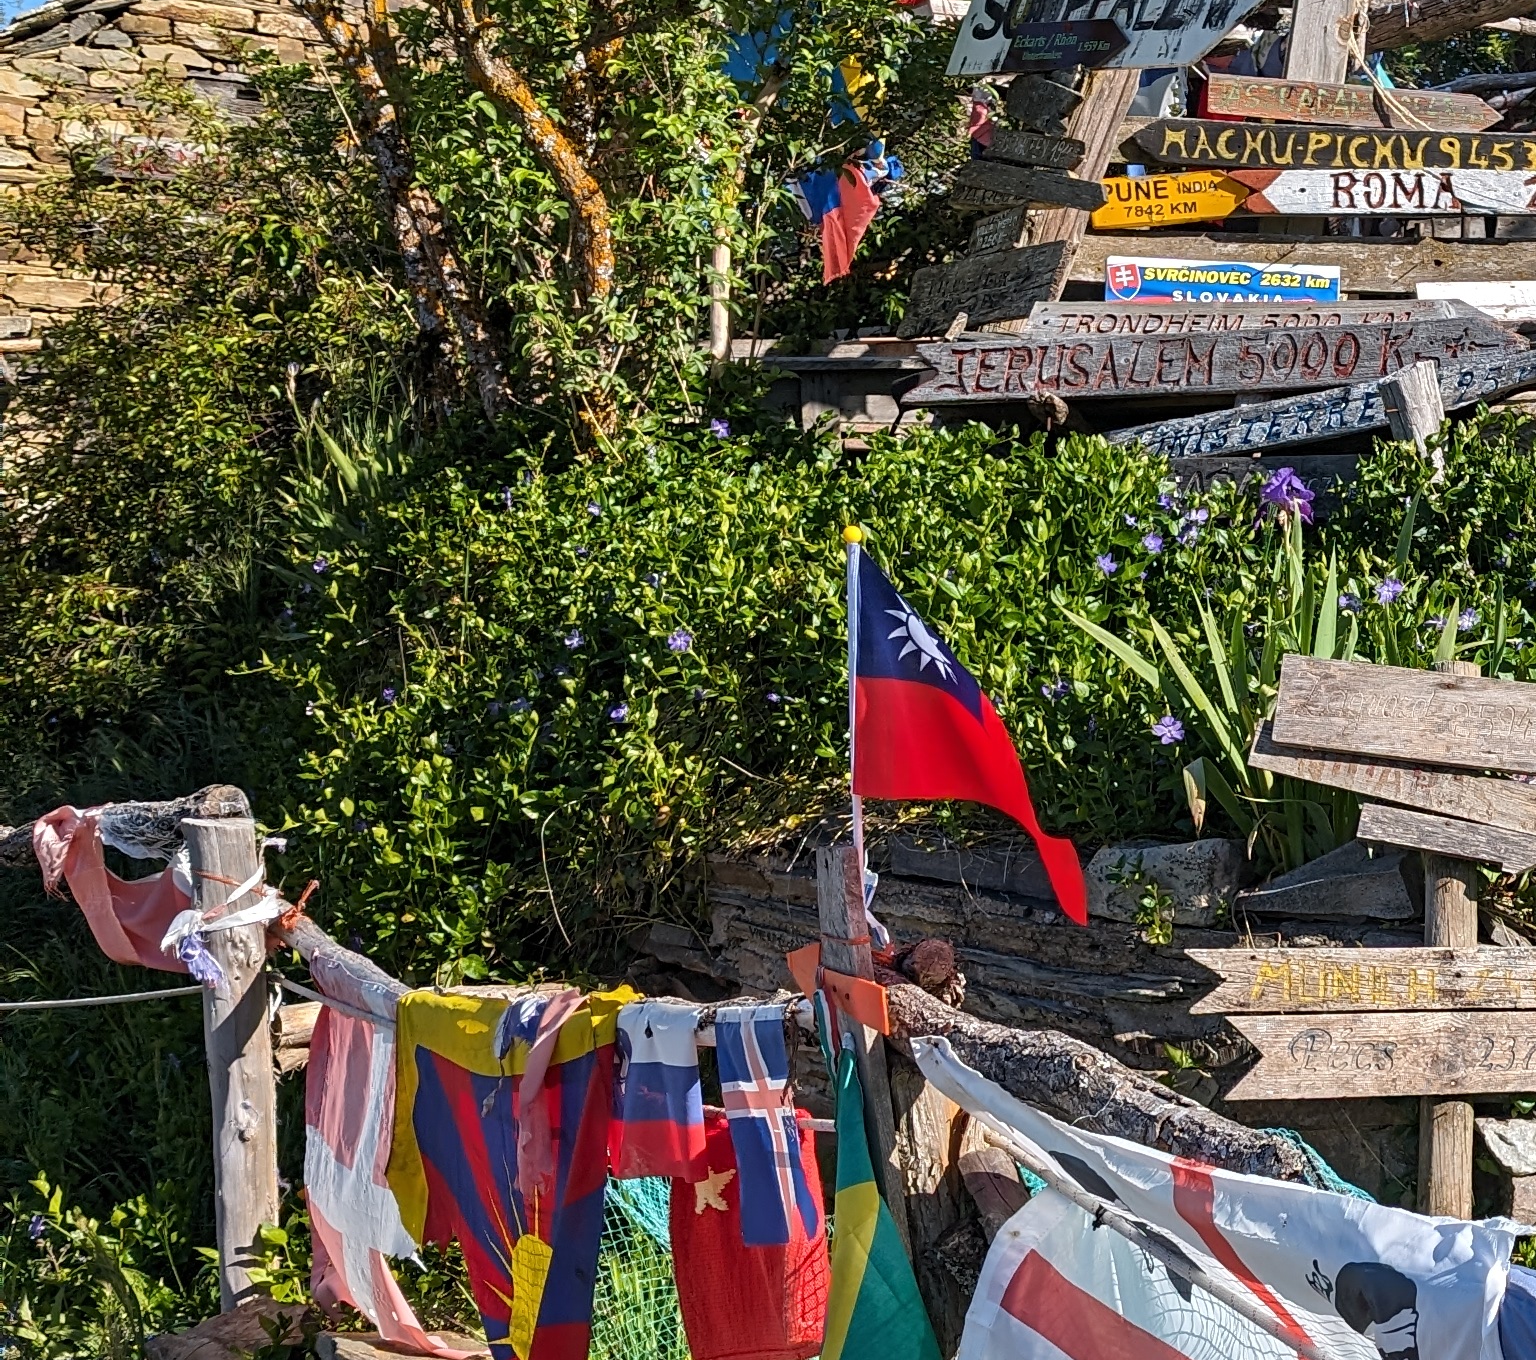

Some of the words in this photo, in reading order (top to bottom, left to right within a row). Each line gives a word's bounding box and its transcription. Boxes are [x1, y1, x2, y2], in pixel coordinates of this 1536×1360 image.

[1177, 179, 1218, 194] INDIA
[1329, 171, 1461, 210] ROMA
[1123, 203, 1165, 218] 7842
[1170, 202, 1198, 215] KM
[1143, 266, 1252, 285] SVRČINOVEC
[1260, 275, 1302, 289] 2632
[1305, 276, 1331, 289] km
[1172, 290, 1284, 303] SLOVAKIA
[1058, 313, 1245, 334] TRONDHEIM
[938, 338, 1218, 394] JERUSALEM
[1236, 331, 1357, 387] 5000
[1288, 1028, 1398, 1075] Pécs
